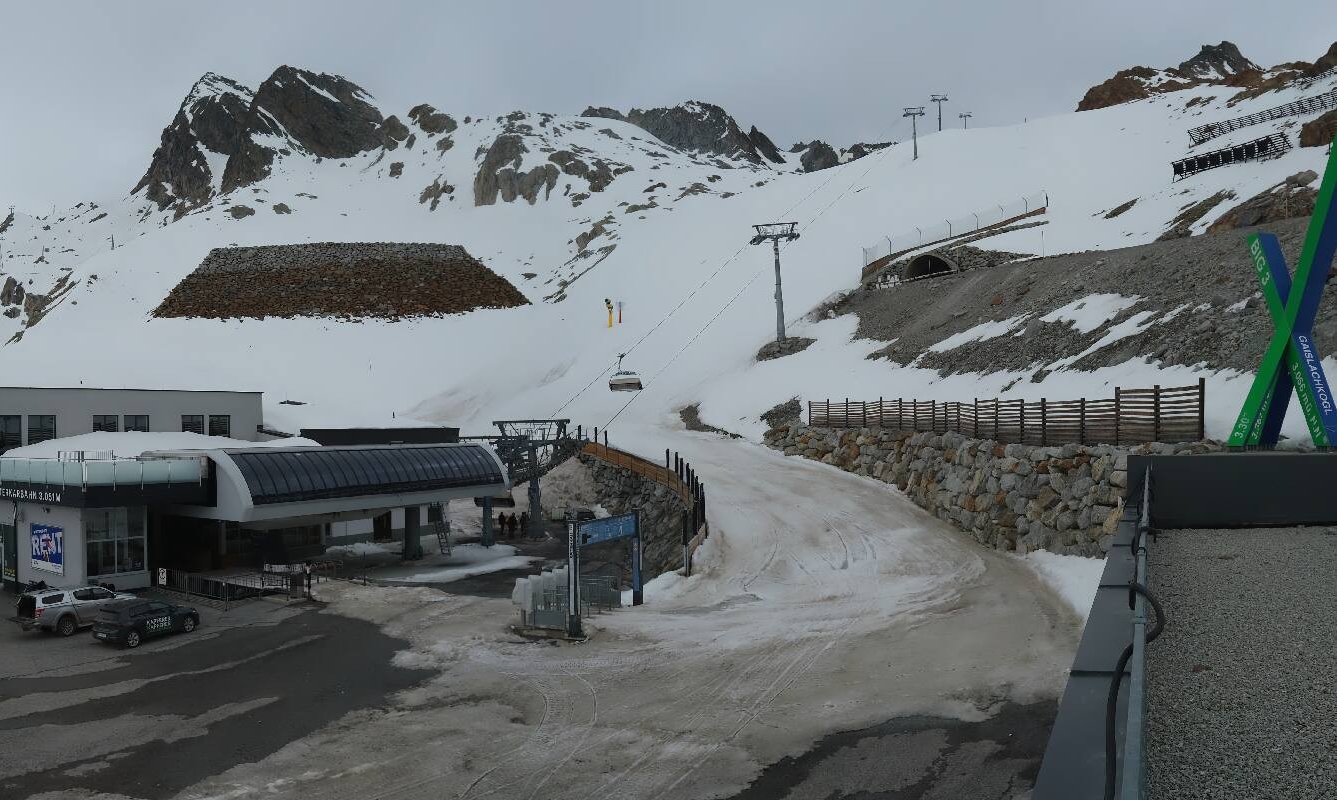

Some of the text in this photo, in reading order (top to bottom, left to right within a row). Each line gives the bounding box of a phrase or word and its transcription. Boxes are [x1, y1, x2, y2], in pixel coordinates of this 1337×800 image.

[1249, 238, 1271, 286] BIG 3
[1298, 335, 1333, 415] GAISLACHKOGL
[38, 491, 55, 502] 3.051
[55, 493, 61, 503] M
